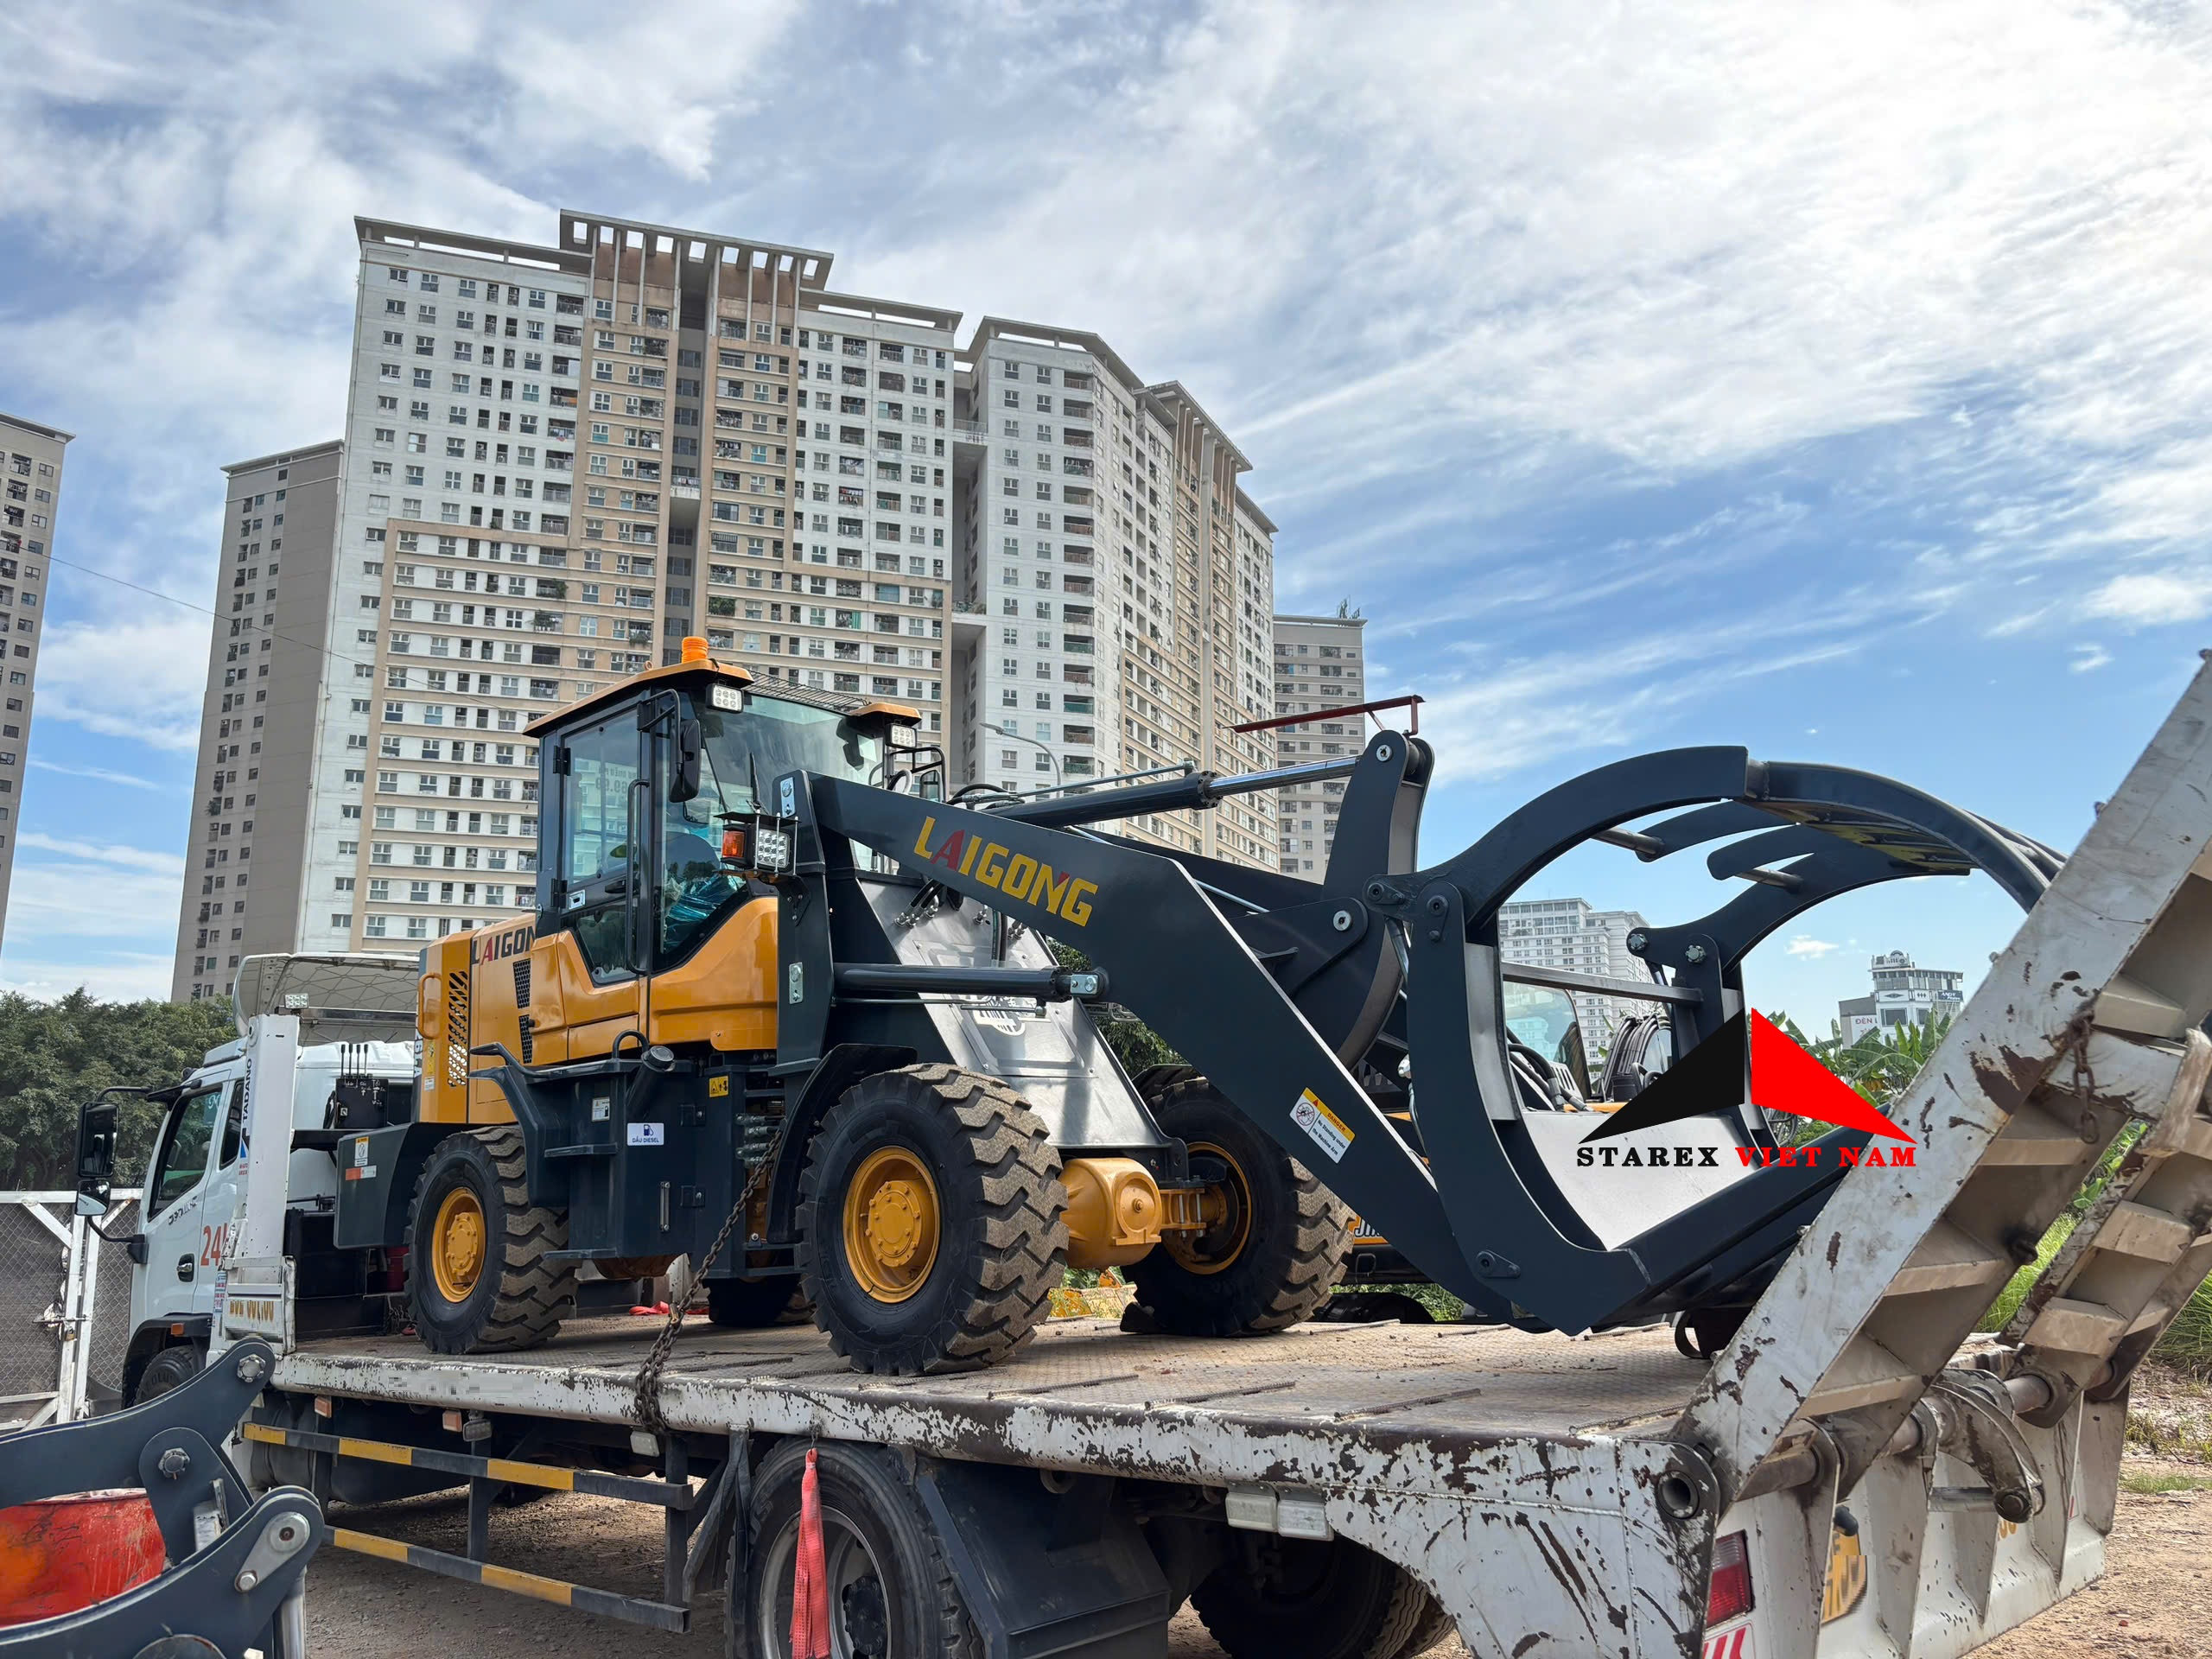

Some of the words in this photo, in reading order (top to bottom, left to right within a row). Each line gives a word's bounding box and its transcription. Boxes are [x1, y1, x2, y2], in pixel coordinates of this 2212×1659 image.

[913, 816, 1099, 926] LAIGONG
[471, 925, 536, 965] LAIGON
[242, 1058, 252, 1122] TADANO
[1322, 1124, 1337, 1141] Standing
[1336, 1138, 1346, 1149] under
[1327, 1112, 1346, 1132] DANGER
[1318, 1133, 1332, 1148] Machine
